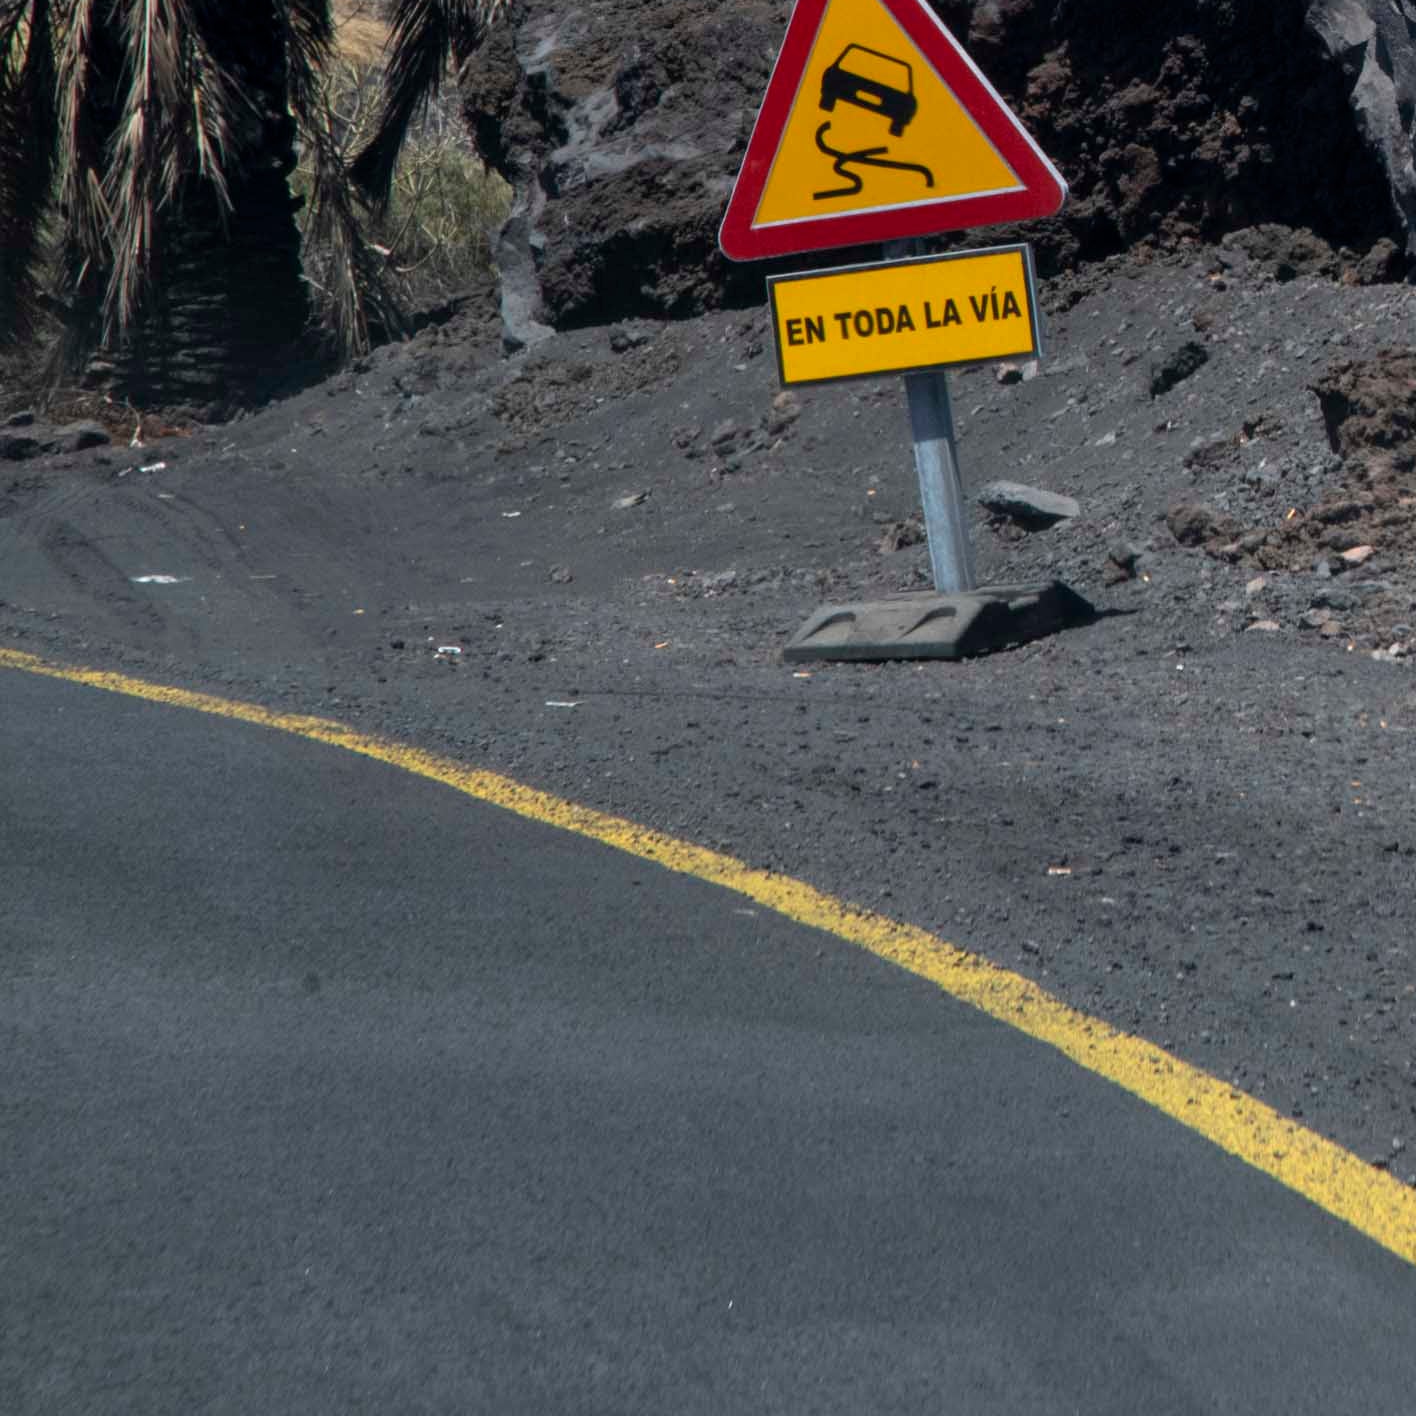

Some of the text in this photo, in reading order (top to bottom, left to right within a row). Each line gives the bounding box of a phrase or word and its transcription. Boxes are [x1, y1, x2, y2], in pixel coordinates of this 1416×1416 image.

[786, 286, 1021, 346] EN TODA LA VÍA
